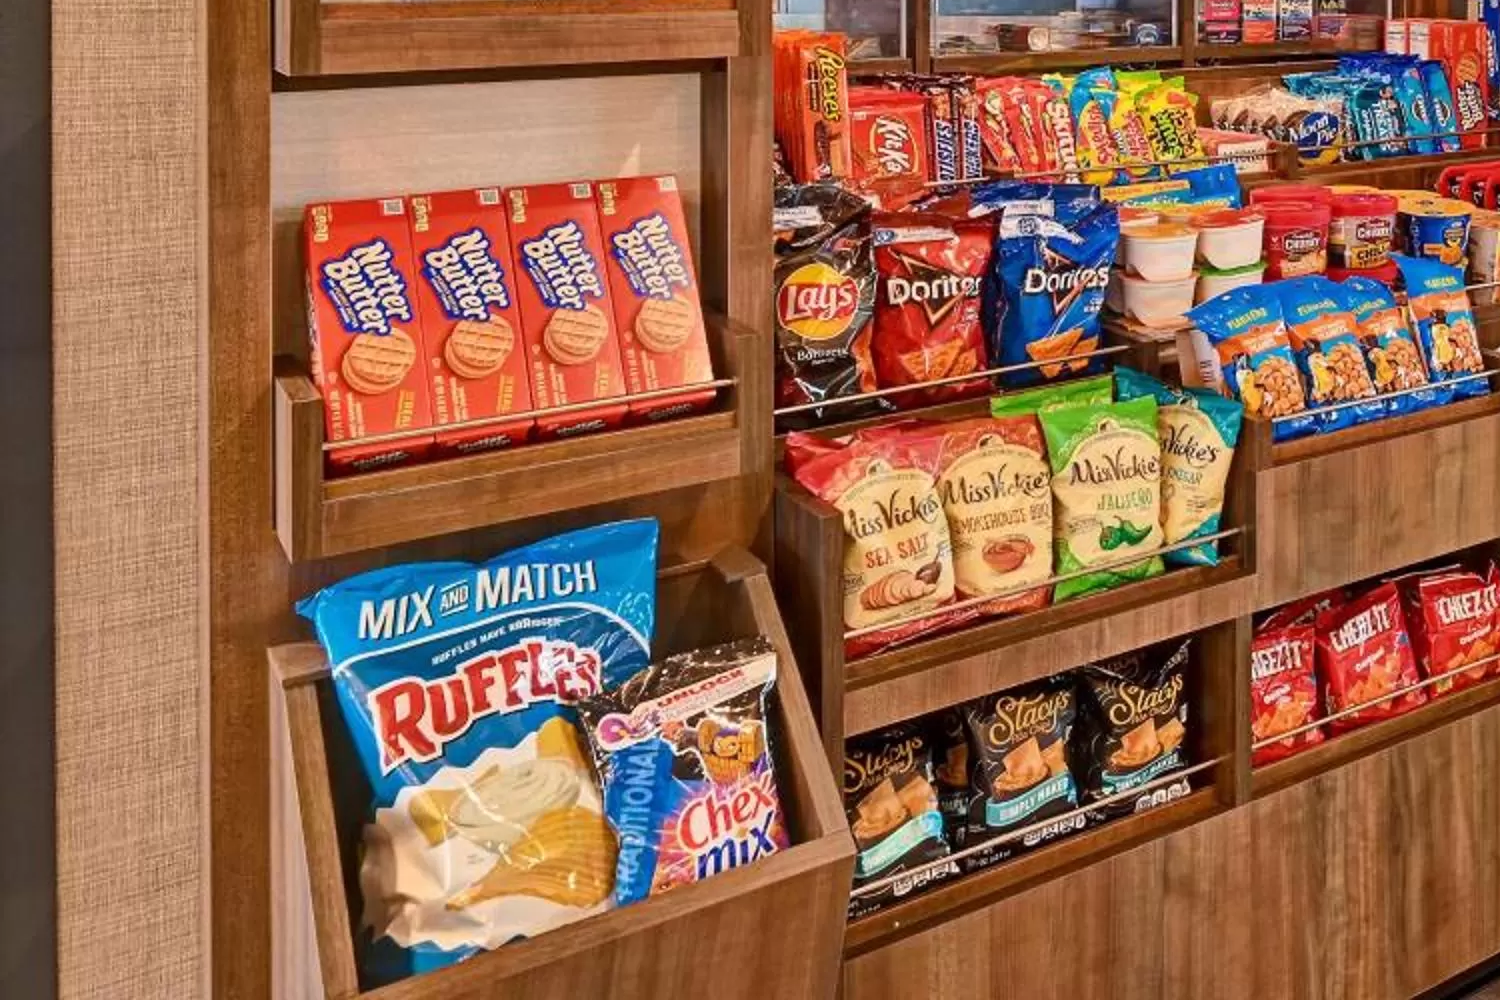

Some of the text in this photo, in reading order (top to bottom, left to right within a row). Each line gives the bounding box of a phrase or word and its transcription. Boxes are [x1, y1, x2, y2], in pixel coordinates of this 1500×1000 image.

[876, 117, 910, 174] KitKa
[352, 240, 411, 321] Nutter
[425, 247, 489, 320] Butter
[452, 229, 509, 308] Nutter
[523, 237, 584, 309] Butter
[548, 221, 603, 297] Nutter
[613, 229, 671, 299] Butter
[636, 214, 689, 289] Nutter
[324, 256, 389, 334] Butter
[866, 531, 930, 569] SEA SALT
[358, 560, 598, 640] MIX AND MATCH
[989, 690, 1072, 745] Stacy's
[1110, 674, 1184, 725] Stacy's
[678, 779, 777, 852] Chex
